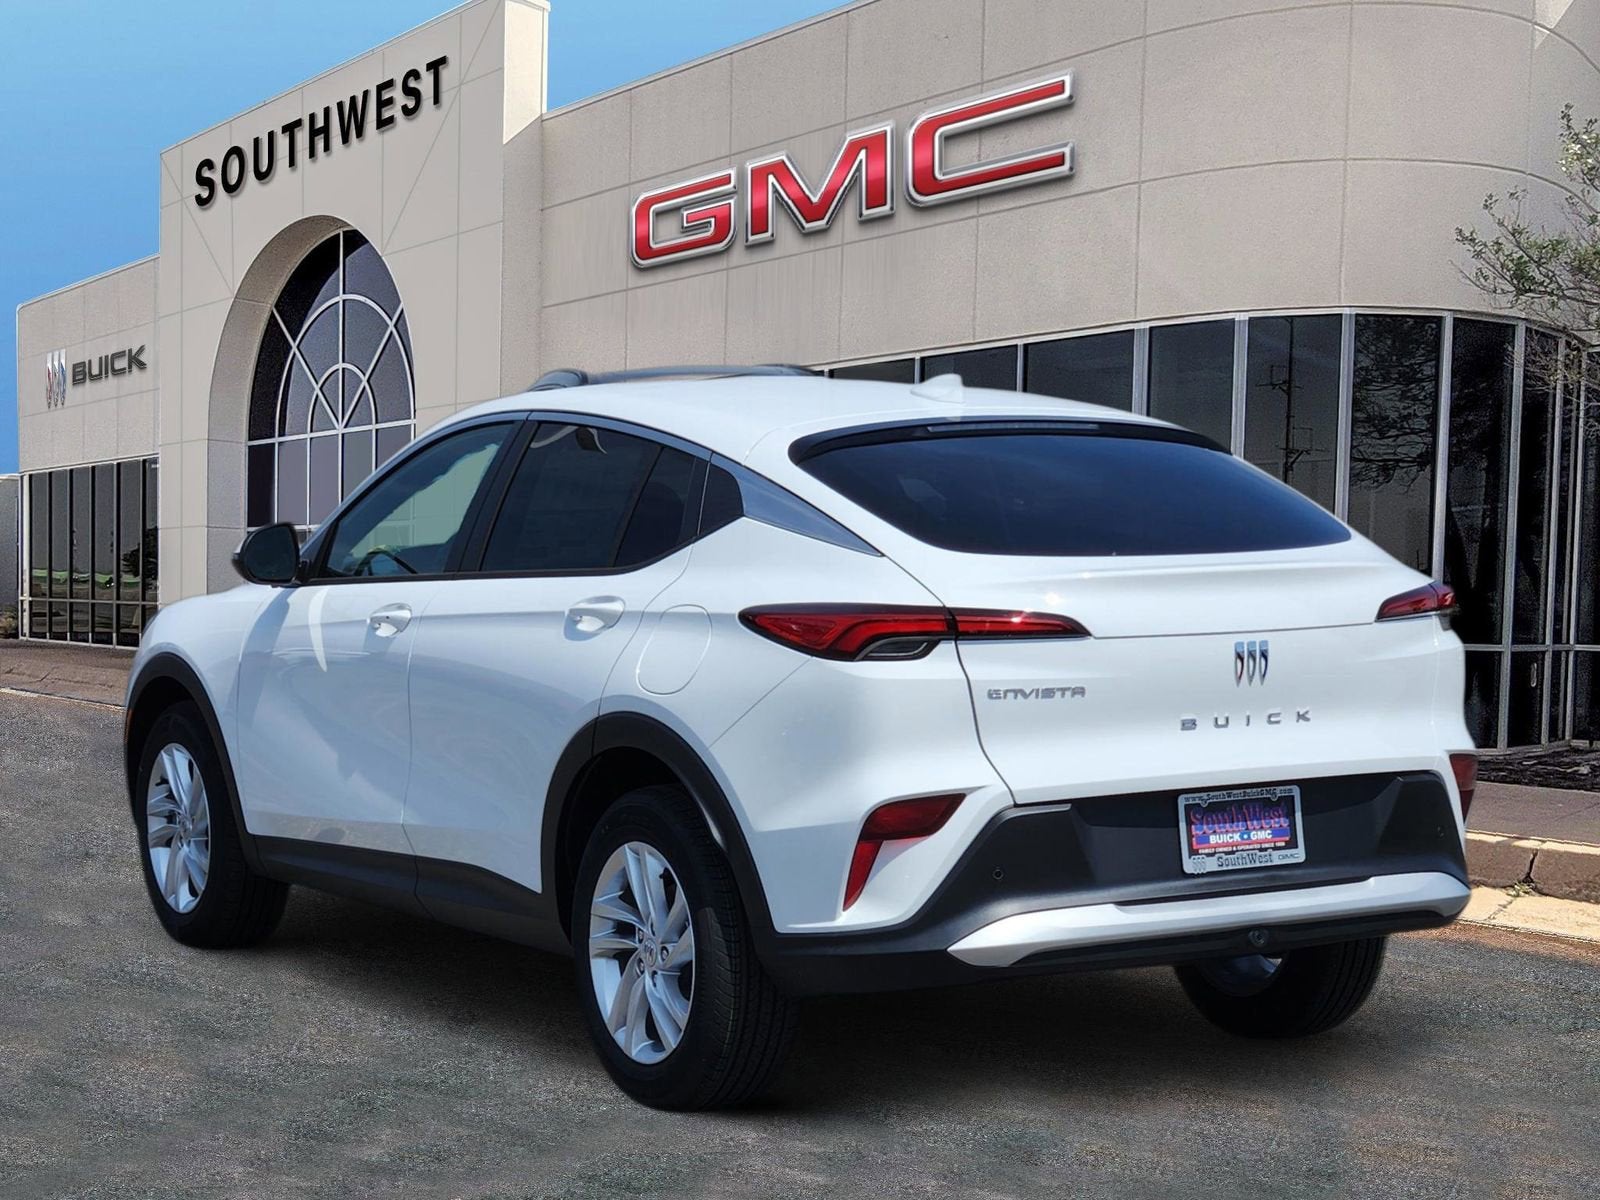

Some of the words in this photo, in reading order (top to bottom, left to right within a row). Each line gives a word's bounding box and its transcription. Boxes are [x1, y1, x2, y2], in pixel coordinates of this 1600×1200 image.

[194, 55, 448, 207] SOUTHWEST
[631, 69, 1075, 268] GMC
[72, 344, 147, 385] BUICK
[987, 686, 1087, 700] ENVISTA
[1180, 710, 1311, 731] BUICK
[1209, 831, 1241, 844] BUICK
[1250, 830, 1273, 840] GMC
[1217, 852, 1273, 867] SouthWest
